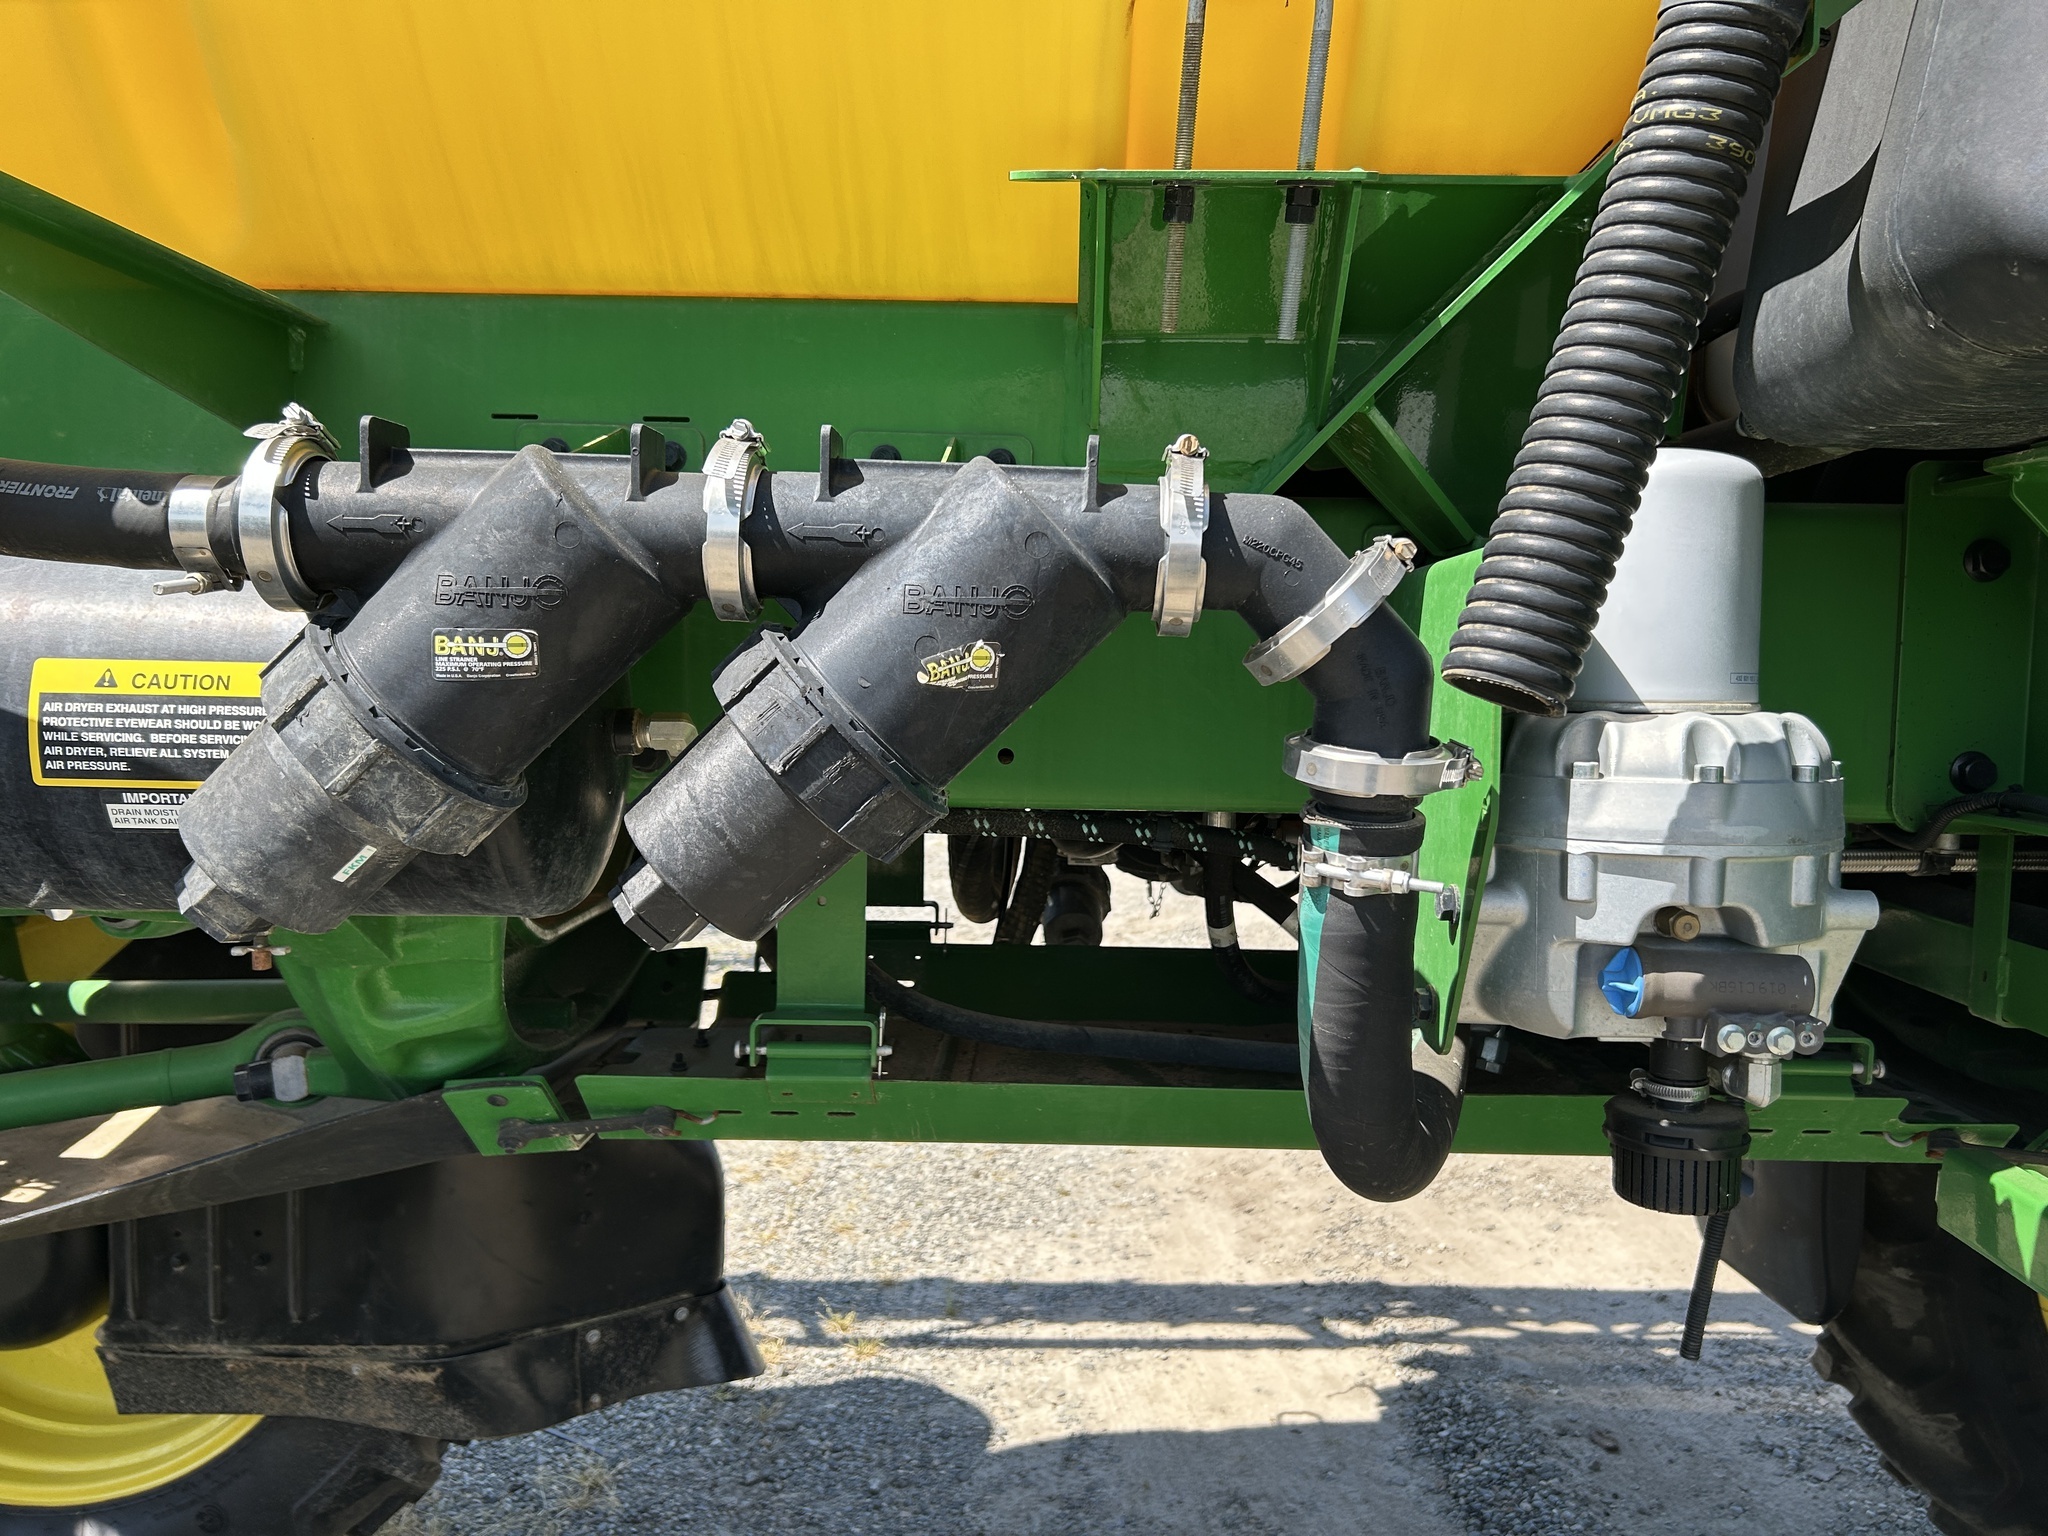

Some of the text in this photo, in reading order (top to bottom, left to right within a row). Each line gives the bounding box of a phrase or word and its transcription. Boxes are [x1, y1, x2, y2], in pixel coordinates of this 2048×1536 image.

[0, 480, 80, 500] FRONTIER
[434, 573, 569, 610] BANJO
[903, 583, 1036, 620] BANJO
[434, 631, 532, 659] BANJO
[926, 644, 995, 682] BANJO
[131, 673, 231, 691] CAUTION
[42, 702, 63, 713] AIR
[64, 702, 104, 714] DRYER
[106, 703, 159, 715] EXHAUST
[160, 704, 176, 715] AT
[177, 704, 206, 716] HIGH
[42, 716, 114, 728] PROTECTIVE
[115, 718, 173, 729] EYEWEAR
[174, 719, 222, 730] SHOULD
[223, 720, 240, 731] BE
[42, 731, 79, 742] WHILE
[80, 732, 145, 743] SERVICING.
[150, 733, 198, 744] BEFORE
[43, 746, 230, 759] AIR DRYER, RELIEVE ALL SYSTEM
[45, 761, 131, 771] AIR PRESSURE.
[111, 808, 142, 816] DRAIN
[132, 817, 159, 825] TANK
[342, 854, 368, 876] FKM
